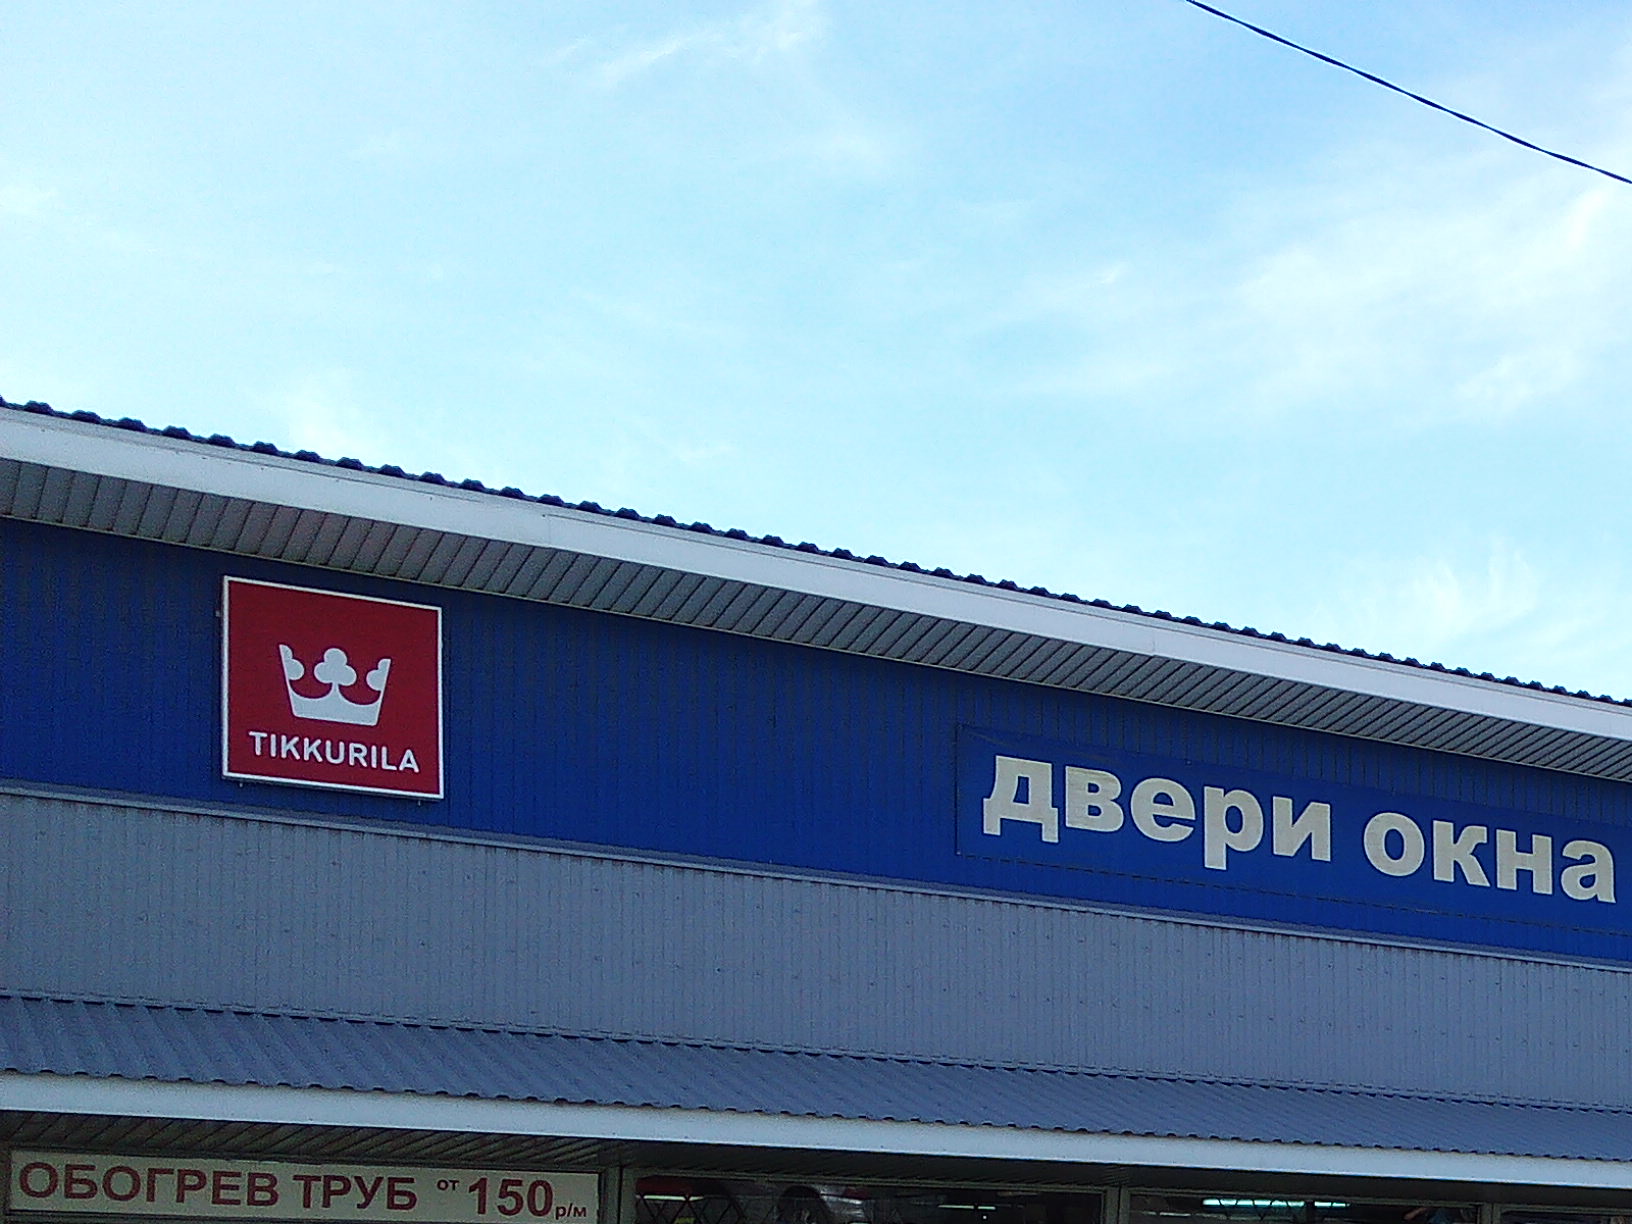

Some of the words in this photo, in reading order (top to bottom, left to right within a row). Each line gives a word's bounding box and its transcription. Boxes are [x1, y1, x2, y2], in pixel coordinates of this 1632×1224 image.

[249, 731, 420, 773] TIKKURILA
[982, 755, 1331, 870] двери
[1363, 811, 1616, 904] окна
[18, 1161, 279, 1206] ОБОГРЕВ
[292, 1173, 418, 1211] ТРУБ
[436, 1178, 460, 1191] от
[467, 1178, 553, 1217] 150
[554, 1203, 587, 1219] р/м
